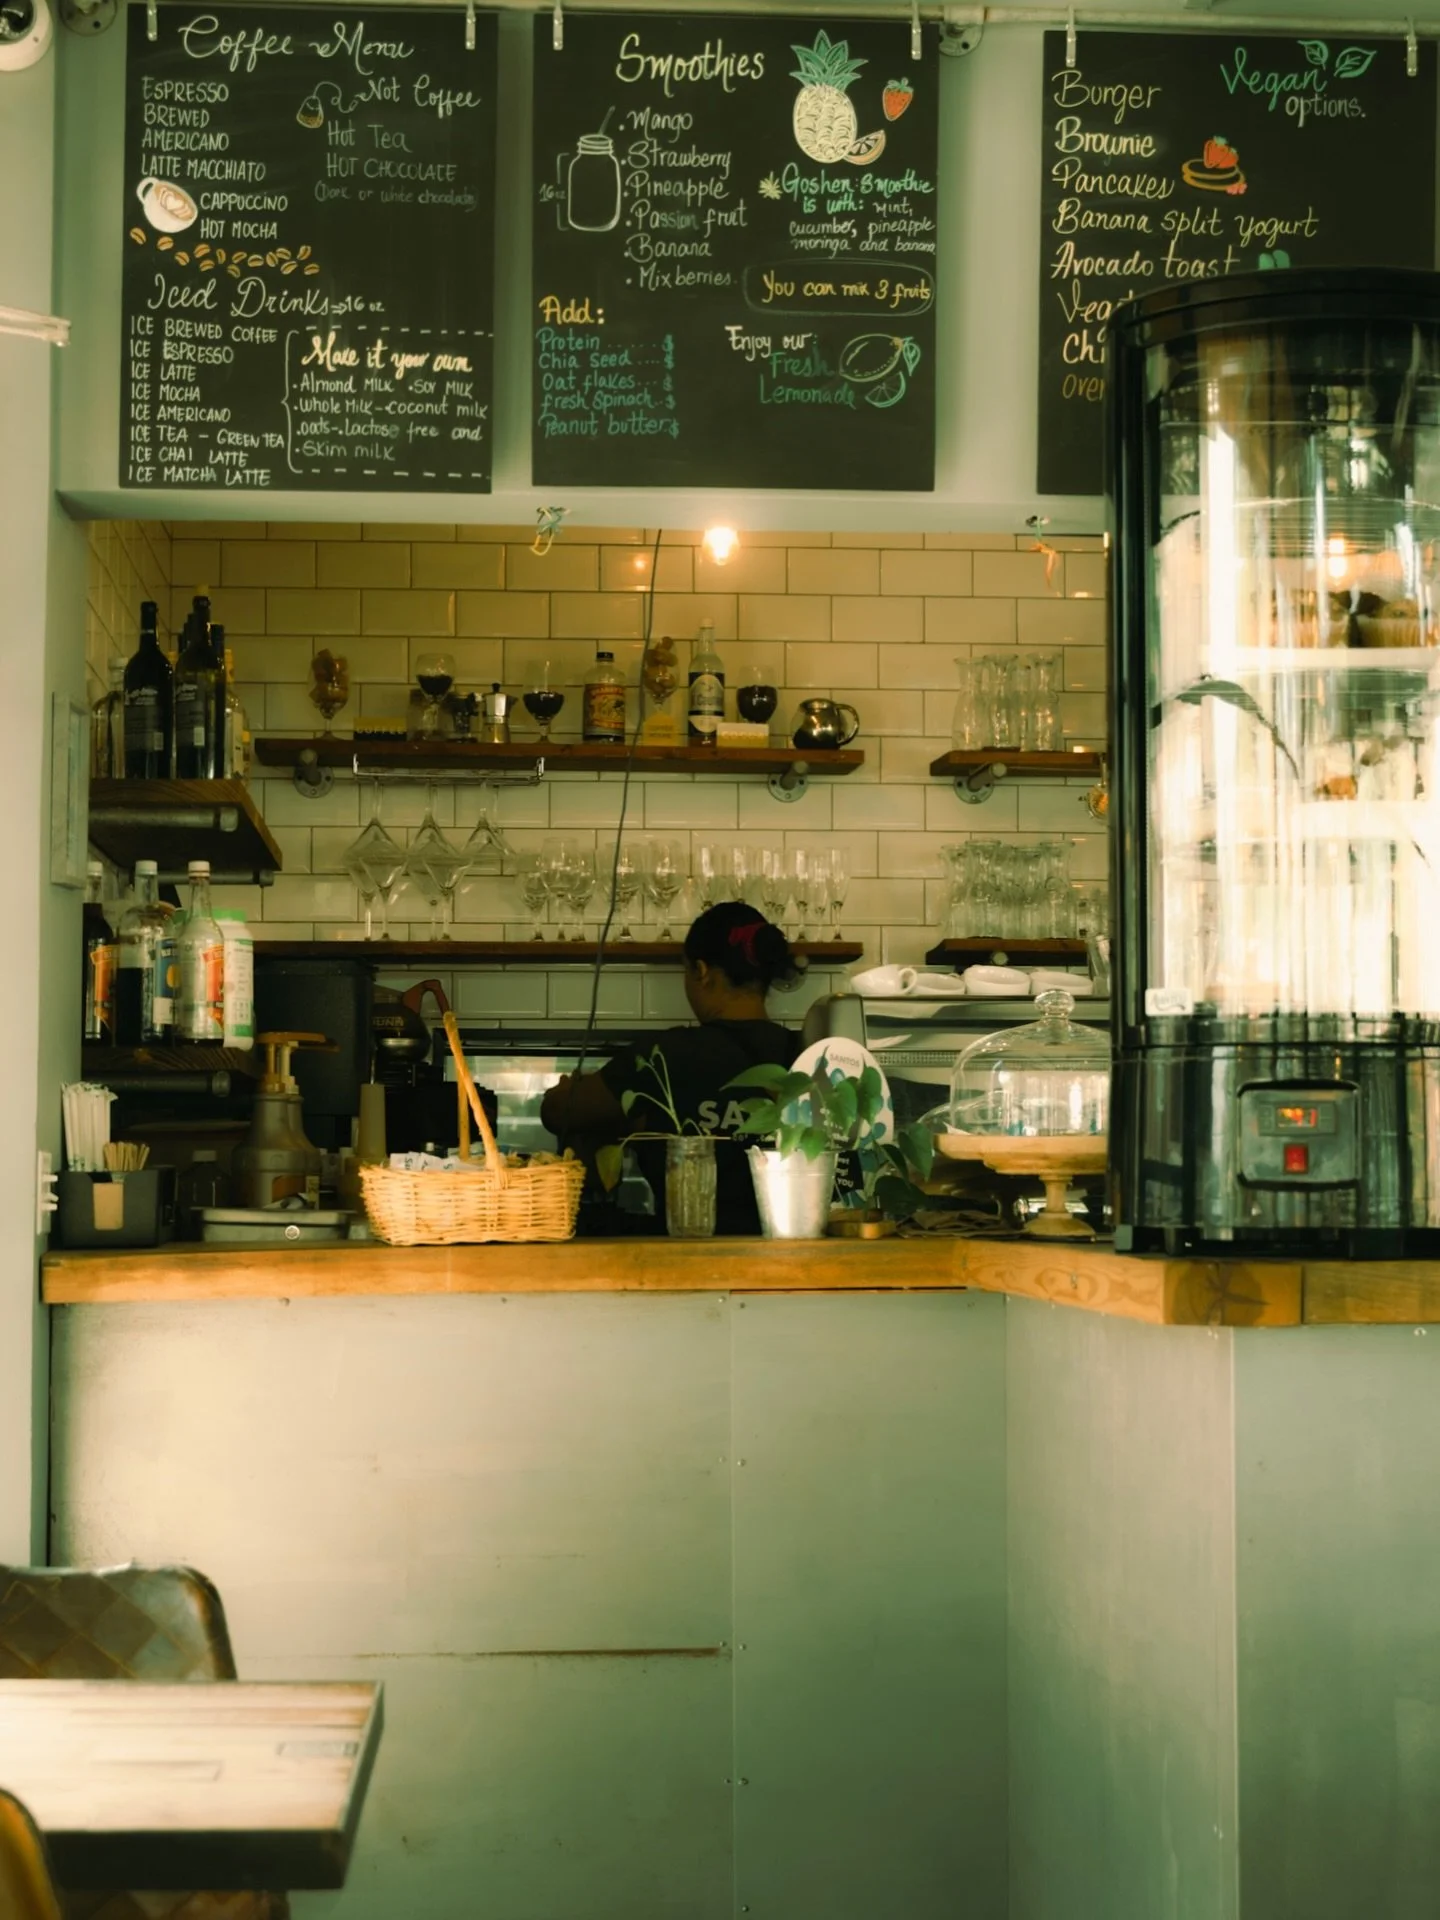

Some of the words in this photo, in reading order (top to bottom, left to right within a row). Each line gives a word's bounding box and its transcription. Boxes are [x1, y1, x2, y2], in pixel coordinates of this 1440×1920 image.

[178, 15, 293, 72] Coffee
[309, 21, 413, 75] Menu
[616, 33, 764, 97] Smoothies
[1220, 47, 1327, 111] Vegan
[142, 75, 229, 103] ESPRESSO
[355, 76, 400, 102] Not
[414, 74, 481, 119] Coffee
[1052, 70, 1161, 124] Burger
[144, 103, 209, 128] BREWED
[627, 106, 692, 143] Mango
[142, 128, 229, 151] AMERICANO
[328, 120, 355, 146] Hot
[367, 124, 412, 152] Tea
[1055, 116, 1156, 160] Brownie
[141, 154, 181, 177] LATTE
[187, 159, 266, 182] MACCHIATO
[327, 153, 358, 177] HOT
[364, 158, 457, 182] CHOCOLATE
[628, 139, 731, 180] Strawberry
[626, 170, 729, 207] Pineapple
[860, 168, 934, 198] Smoothie
[1052, 157, 1175, 199] Pancakes
[358, 190, 373, 200] or
[381, 186, 413, 203] white
[803, 196, 816, 213] is
[200, 218, 225, 239] HOT
[232, 221, 277, 239] MOCHA
[630, 199, 698, 230] Passion
[703, 199, 748, 238] fruit
[868, 216, 935, 241] pineapple
[1052, 199, 1152, 234] Banana
[1161, 207, 1224, 244] split
[1235, 206, 1320, 247] yogurt
[626, 233, 712, 263] Banana
[791, 238, 851, 259] moringa
[859, 237, 888, 251] and
[1051, 241, 1154, 279] Avocado
[1160, 240, 1241, 278] toast
[640, 262, 672, 291] Mix
[148, 274, 218, 309] Iced
[369, 302, 384, 312] oz
[803, 282, 836, 296] can
[841, 282, 869, 296] mix
[875, 280, 889, 299] 3
[890, 279, 930, 308] fruits
[538, 296, 604, 324] Add:
[131, 315, 154, 335] ICE
[165, 318, 222, 339] BREWED
[536, 327, 599, 351] Protein
[130, 339, 150, 357] ICE
[163, 339, 234, 364] ESPRESSO
[301, 331, 359, 372] Make
[366, 339, 388, 368] it
[391, 352, 429, 380] your
[433, 354, 472, 372] own
[725, 325, 772, 361] Enjoy
[131, 361, 150, 379] ICE
[160, 363, 196, 381] LATTE
[538, 352, 580, 369] Chia
[770, 347, 834, 379] Fresh
[131, 382, 150, 400] ICE
[159, 384, 200, 401] MOCHA
[300, 371, 356, 393] Almond
[414, 379, 436, 393] SOY
[543, 370, 576, 390] Oat
[760, 374, 857, 410] Lemonade
[131, 403, 150, 420] ICE
[157, 405, 231, 422] AMERICANO
[538, 412, 598, 438] Peanut
[131, 425, 150, 442] ICE
[156, 425, 188, 442] TEA
[217, 428, 259, 447] GREEN
[262, 433, 284, 448] TEA
[407, 422, 439, 443] free
[452, 426, 482, 440] and
[131, 445, 152, 462] ICE
[159, 447, 192, 462] CHAI
[209, 449, 248, 467] LATTE
[129, 465, 156, 482] ICE
[164, 466, 217, 482] MATCHA
[225, 469, 270, 485] LATTE
